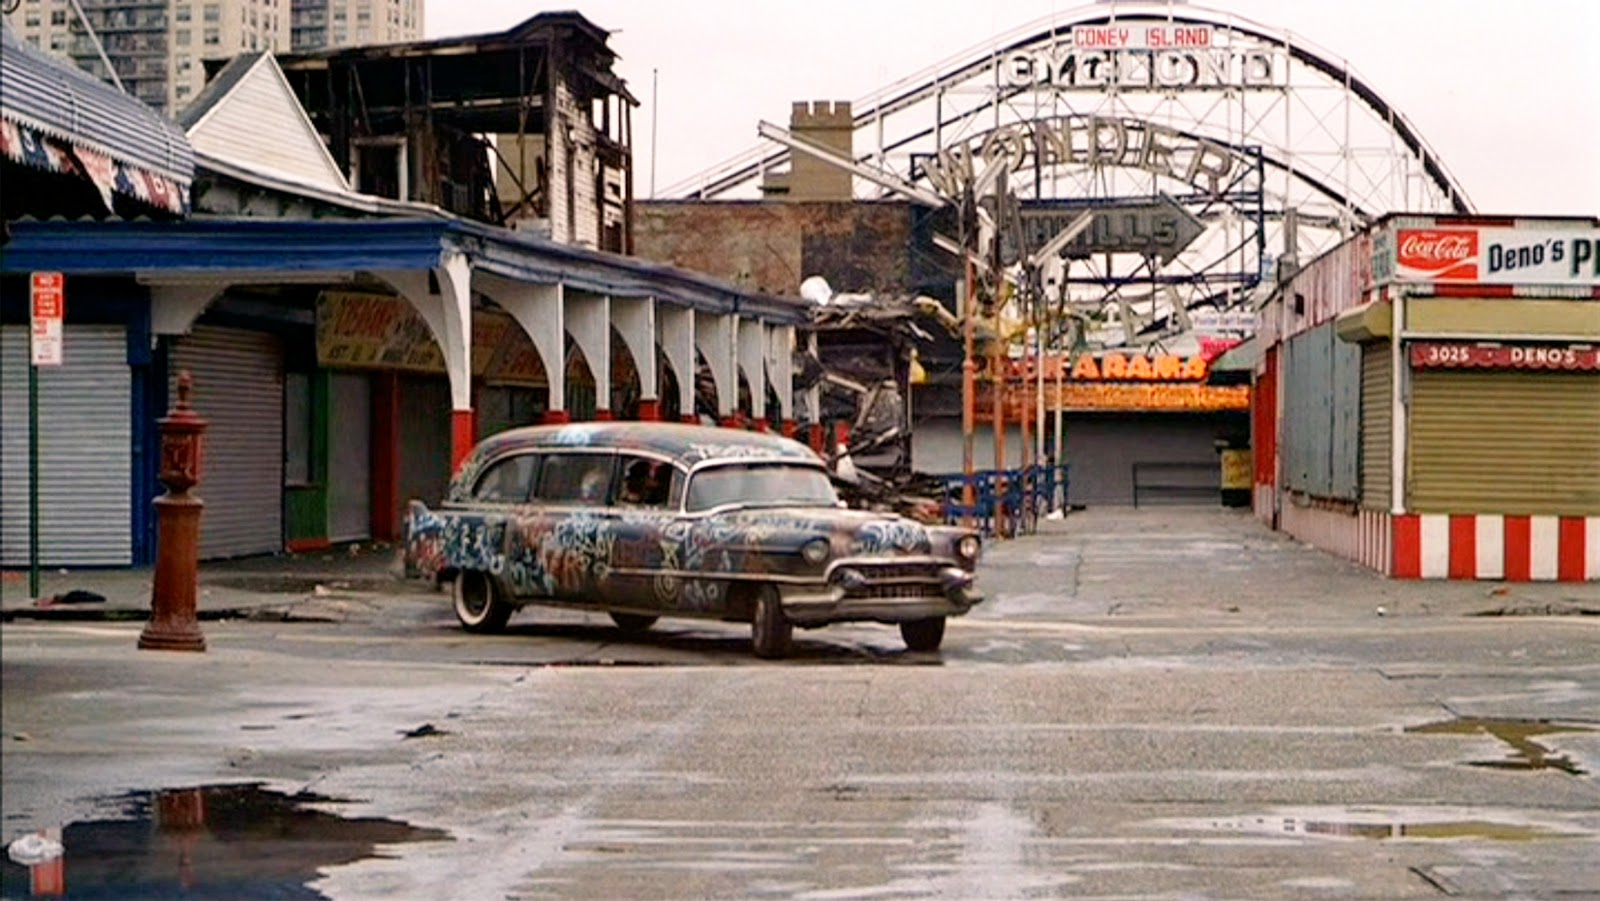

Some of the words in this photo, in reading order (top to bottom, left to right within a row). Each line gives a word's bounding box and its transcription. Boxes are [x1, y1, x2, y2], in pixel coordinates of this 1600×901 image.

[1075, 28, 1129, 46] CONEY
[1145, 27, 1209, 45] ISLAND
[919, 115, 1233, 200] WONDER
[1487, 238, 1565, 274] Deno's
[1429, 348, 1470, 361] 3025
[1510, 348, 1577, 362] DENO'S
